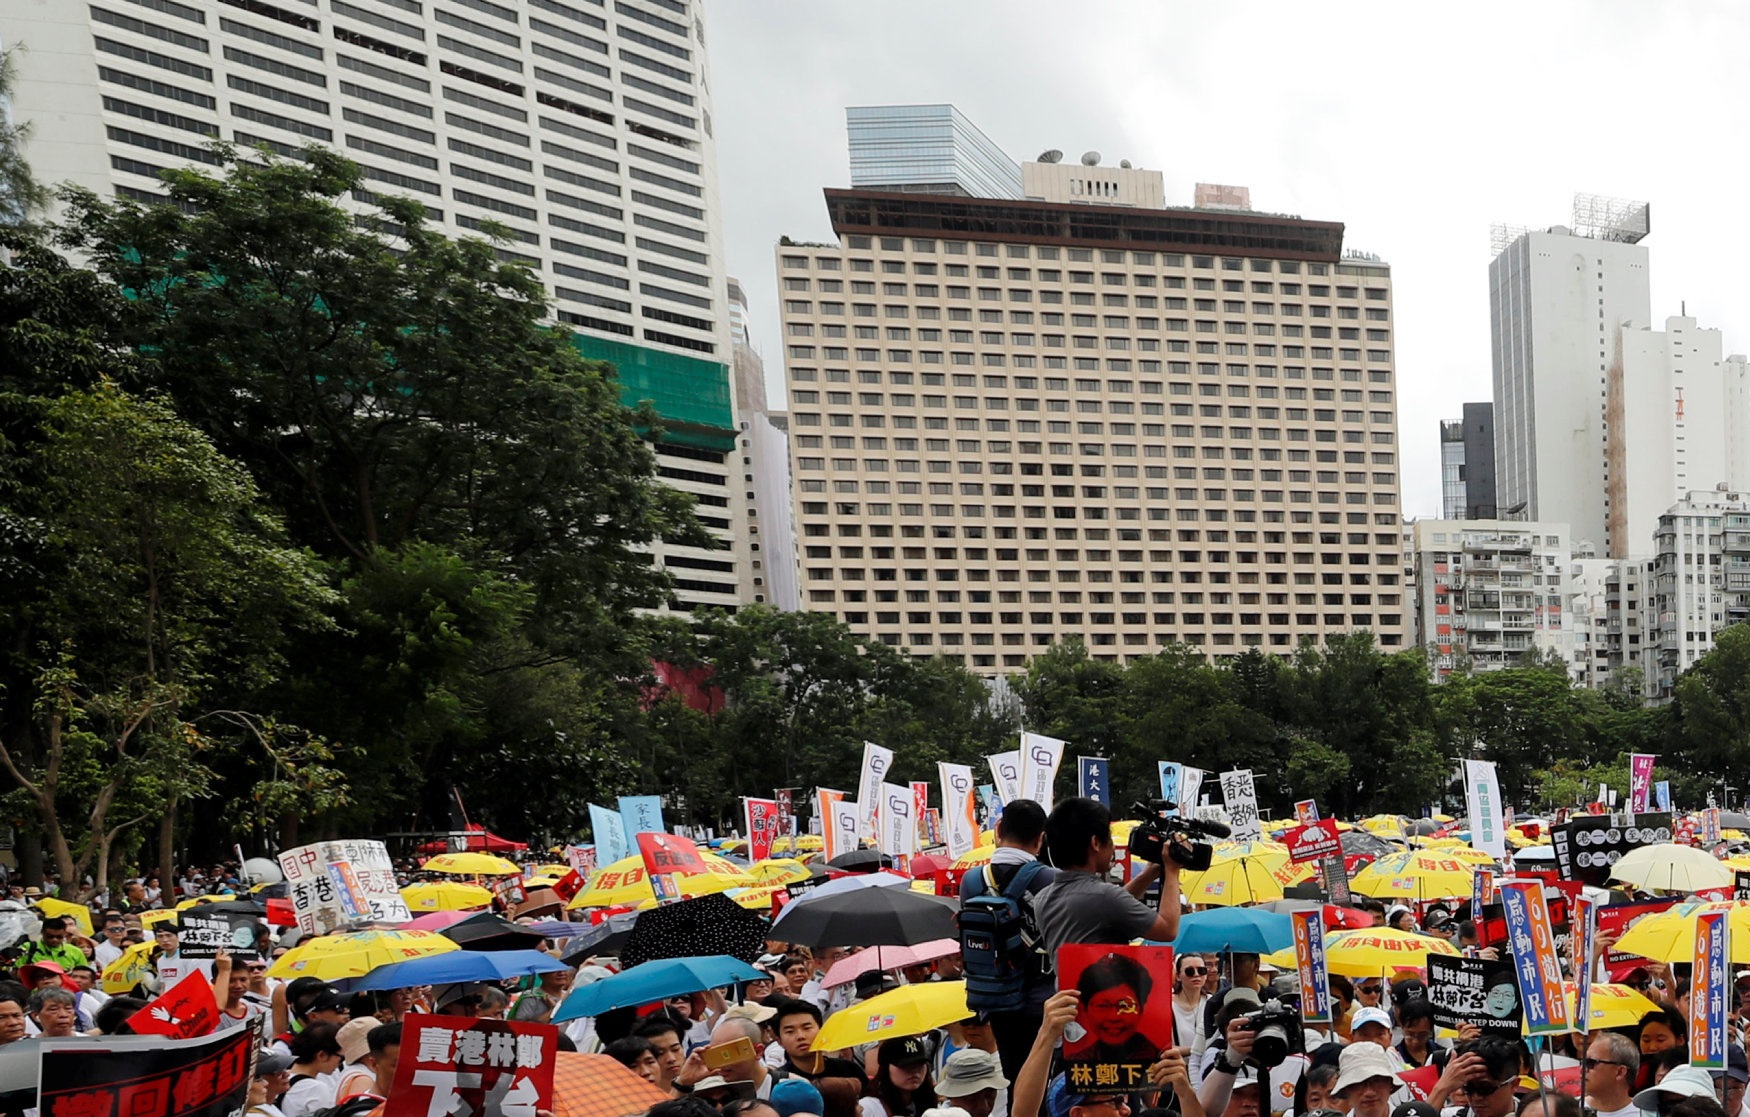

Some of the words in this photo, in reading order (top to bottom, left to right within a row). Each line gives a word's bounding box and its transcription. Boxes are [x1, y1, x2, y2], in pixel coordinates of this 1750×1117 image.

[968, 939, 990, 950] LiveU
[1296, 925, 1315, 1014] 69遊行
[1307, 915, 1327, 1013] 感動市民
[1510, 893, 1545, 1021] 感動市民
[1531, 898, 1564, 1018] 69遊行
[1711, 922, 1722, 1055] 感動市民
[1430, 985, 1487, 1011] 林鄭下台
[1468, 1018, 1488, 1027] STEP
[1489, 1019, 1518, 1028] DOWN!
[1694, 931, 1707, 1058] 69遊行
[416, 1026, 544, 1070] 賣港林鄭
